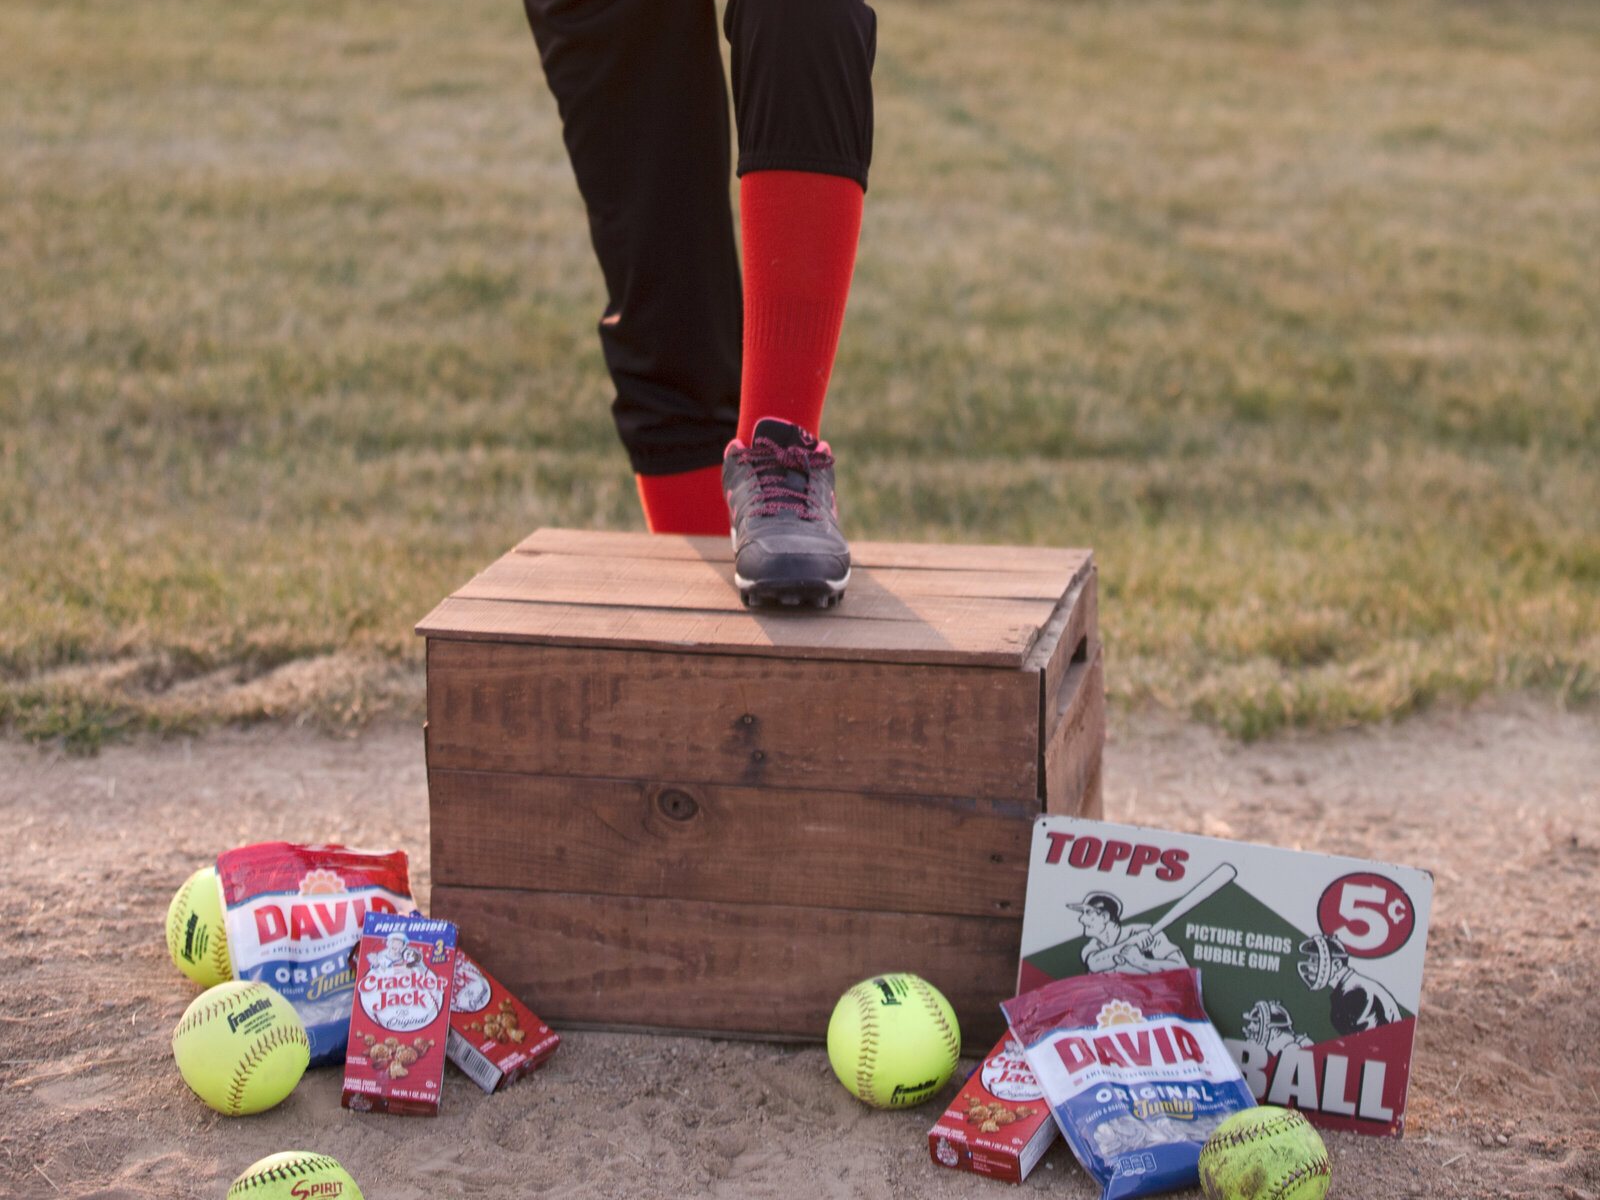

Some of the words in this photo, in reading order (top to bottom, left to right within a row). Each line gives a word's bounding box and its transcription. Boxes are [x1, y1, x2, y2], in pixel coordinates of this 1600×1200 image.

[1045, 831, 1190, 883] TOPPS
[374, 922, 407, 933] PRIZE
[408, 922, 448, 932] INSIDE!
[434, 939, 444, 956] 3
[1185, 923, 1243, 948] PICTURE
[1245, 931, 1292, 955] CARDS
[275, 953, 349, 984] ORIGI
[1193, 944, 1246, 968] BUBBLE
[1248, 952, 1281, 972] GUM
[306, 968, 356, 1001] Jum
[360, 972, 448, 993] Cracker
[373, 990, 427, 1011] Jack
[227, 997, 272, 1033] Franklin
[386, 1014, 429, 1028] Original
[1054, 1026, 1204, 1075] DAVID
[1095, 1085, 1214, 1104] ORIGINAL
[1132, 1097, 1194, 1119] Jumbo
[290, 1179, 343, 1200] SPIRIT
